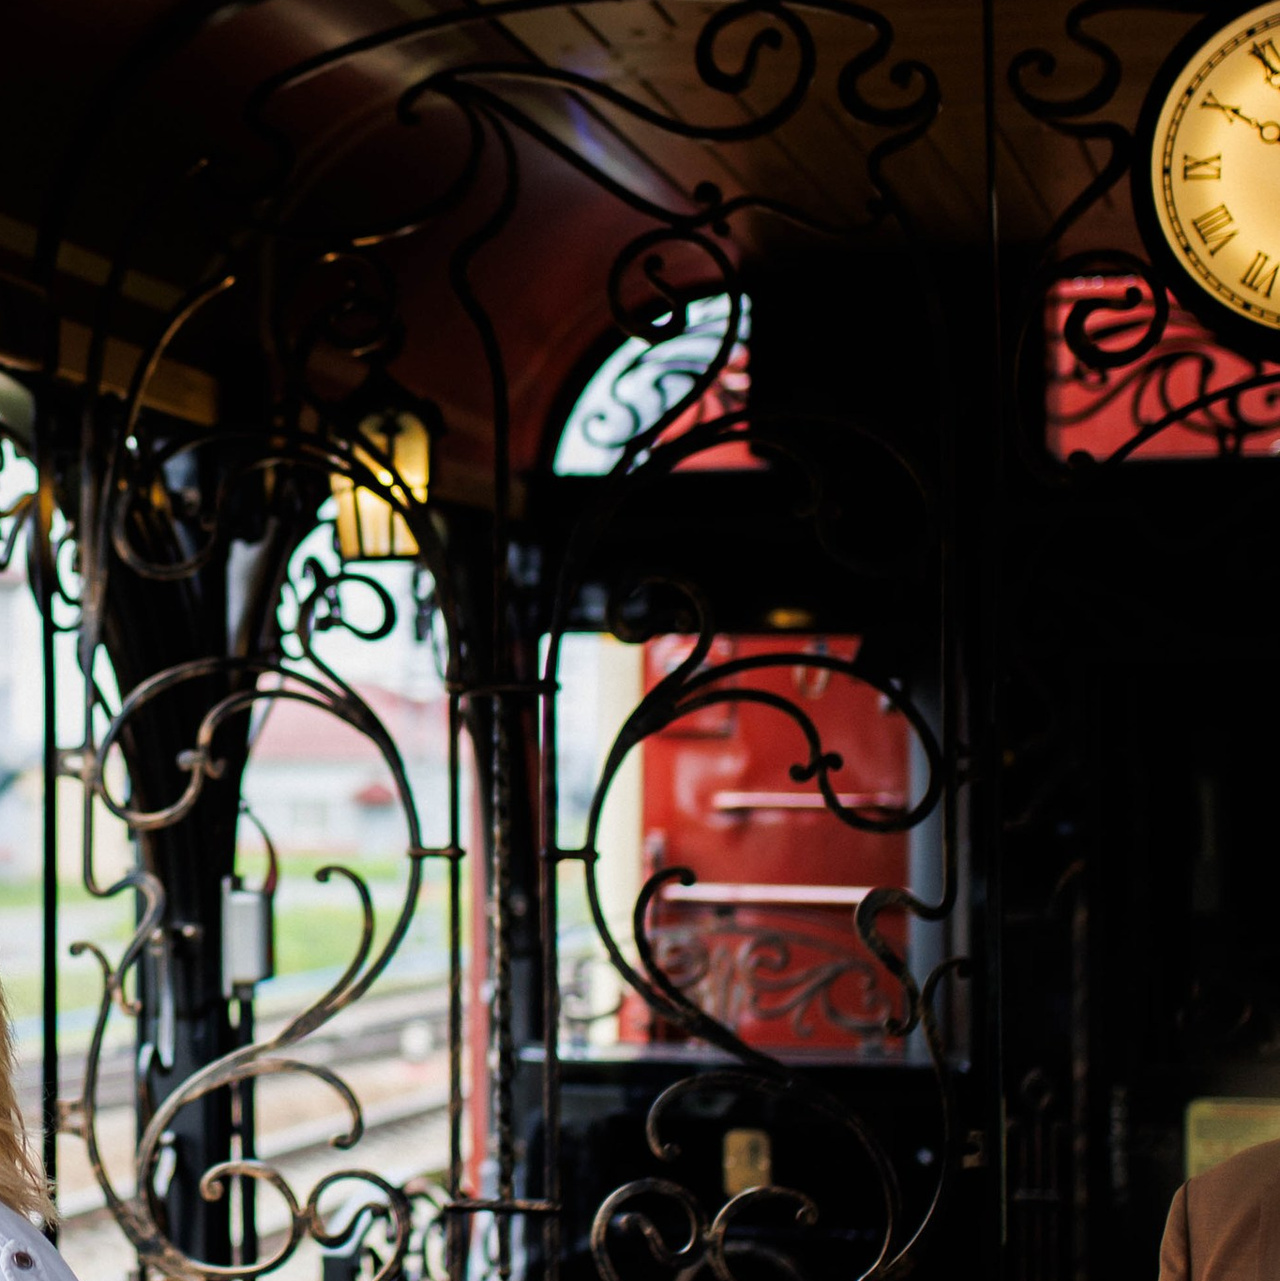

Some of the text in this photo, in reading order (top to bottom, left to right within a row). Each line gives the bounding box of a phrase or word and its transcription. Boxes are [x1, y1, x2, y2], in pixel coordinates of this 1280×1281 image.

[1200, 90, 1240, 124] X
[1183, 153, 1222, 181] IX
[1192, 204, 1239, 258] VIII
[1240, 250, 1280, 299] VII
